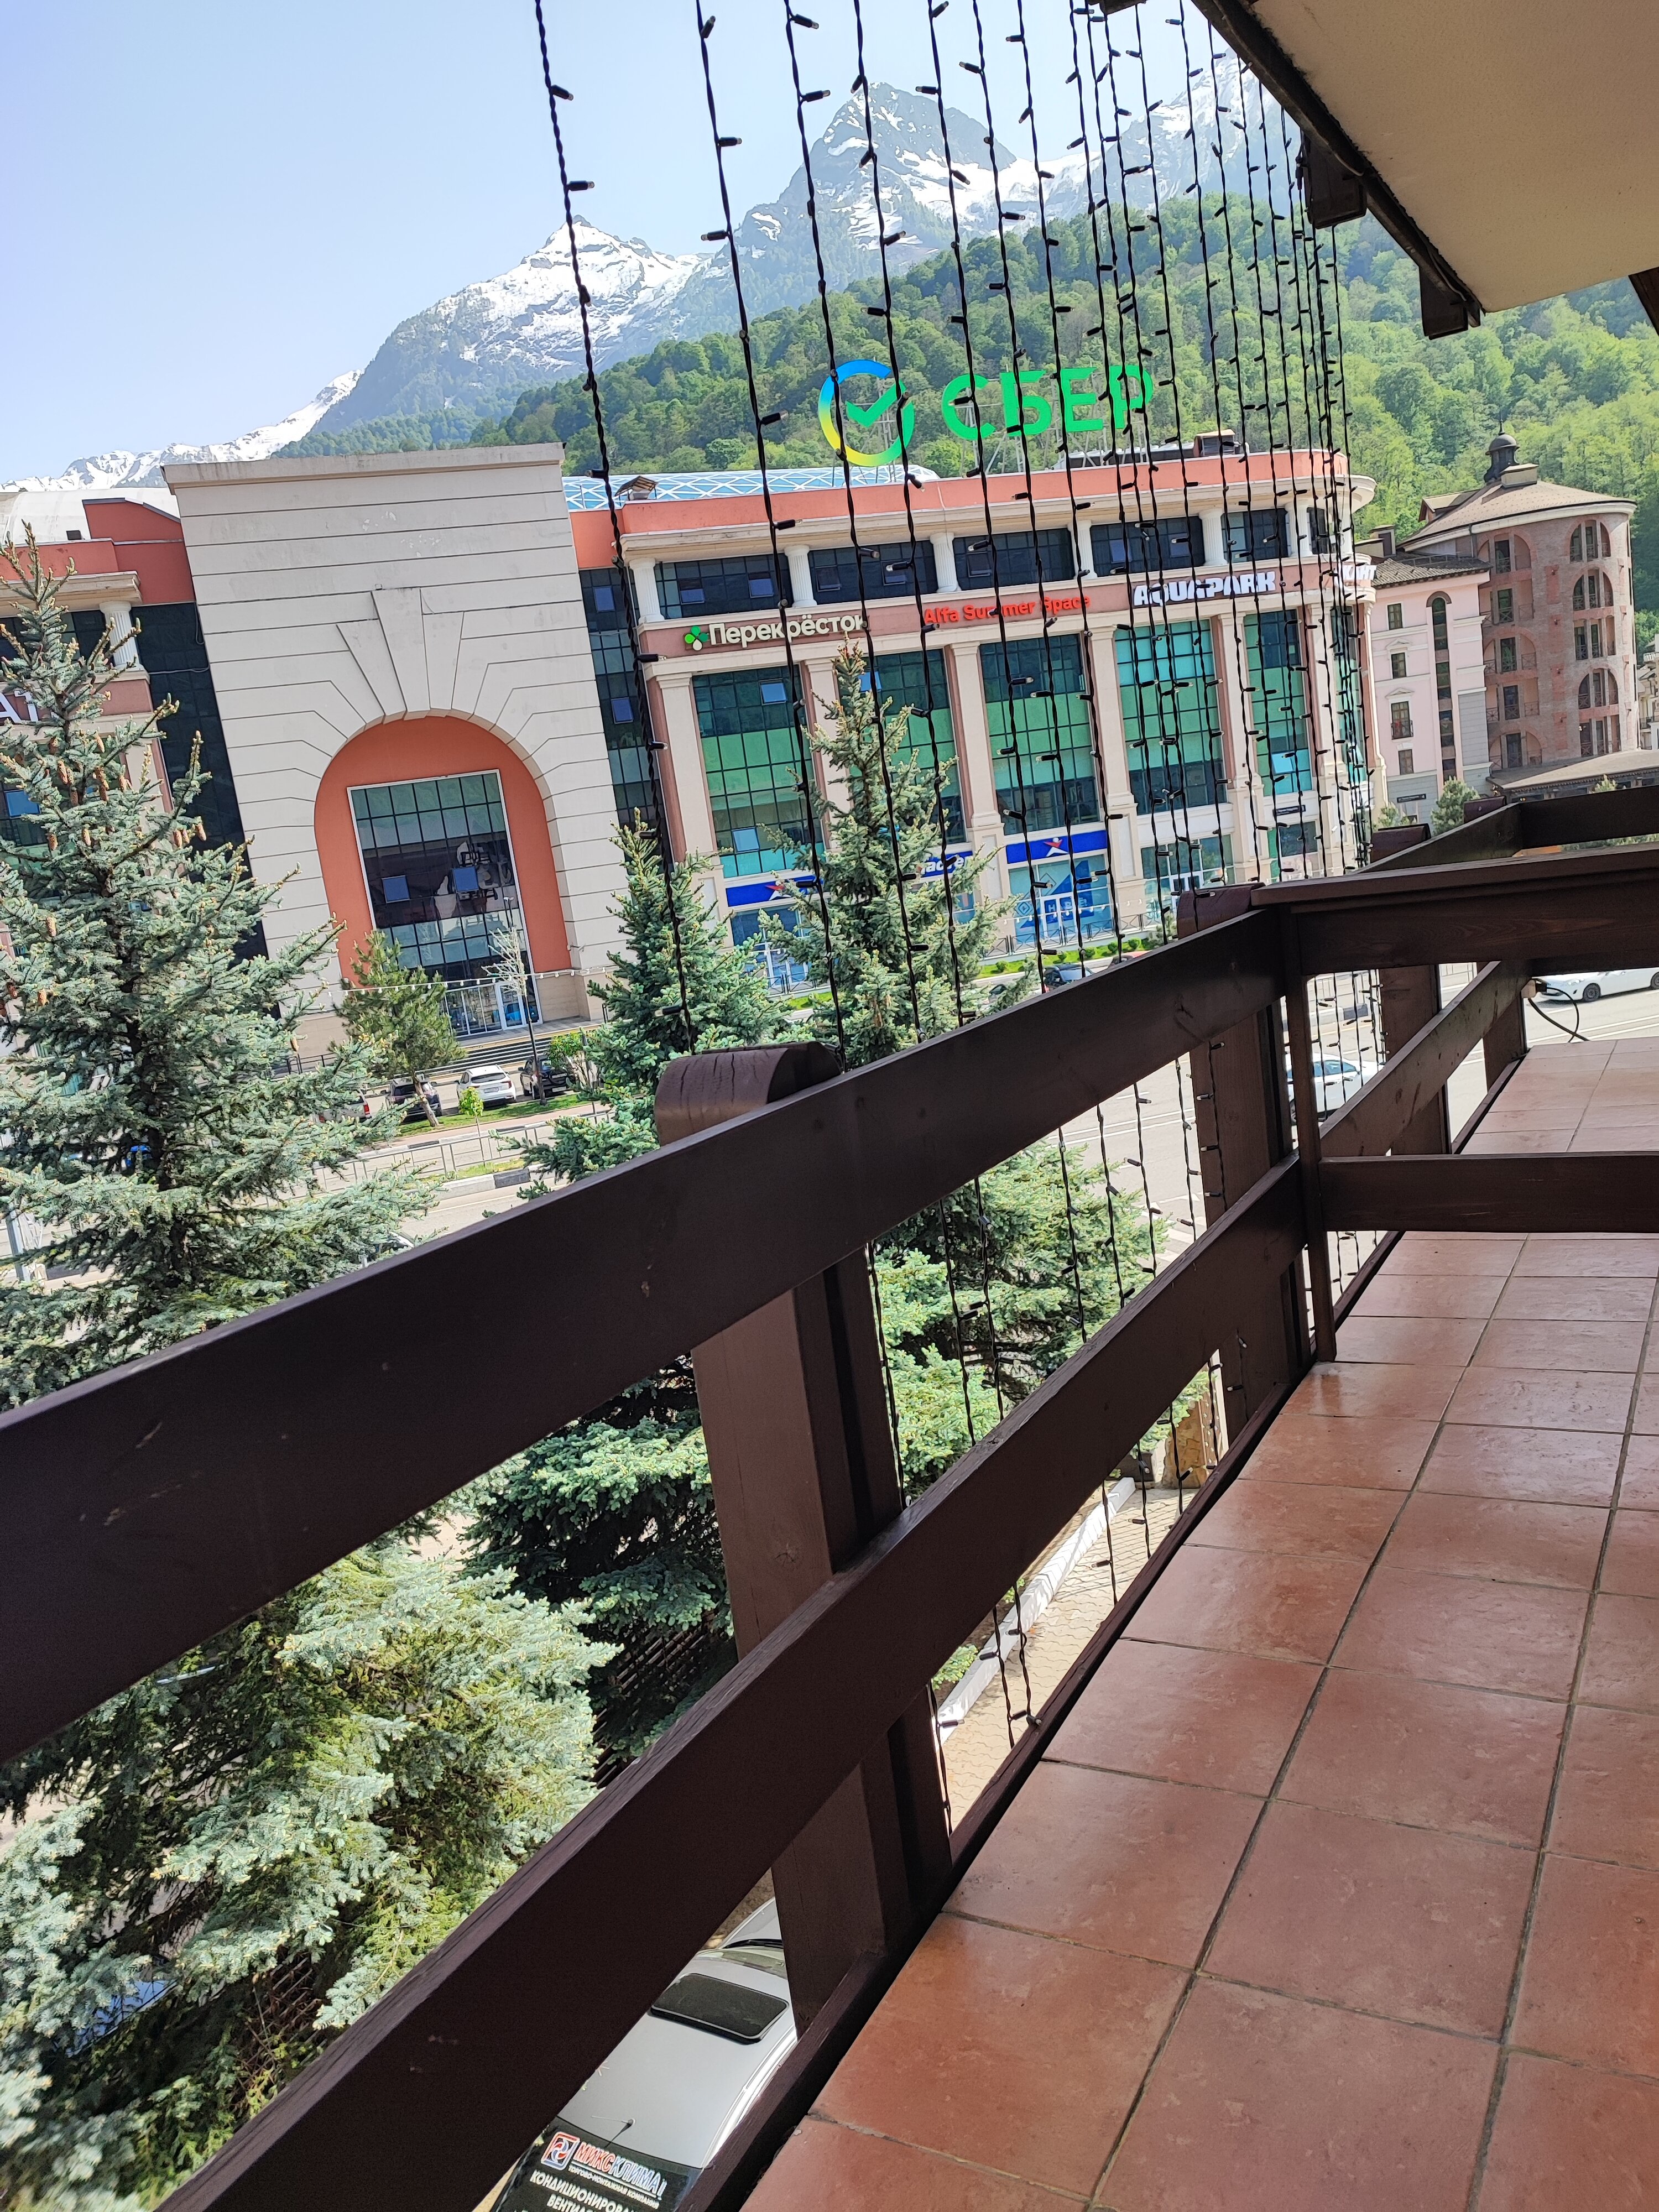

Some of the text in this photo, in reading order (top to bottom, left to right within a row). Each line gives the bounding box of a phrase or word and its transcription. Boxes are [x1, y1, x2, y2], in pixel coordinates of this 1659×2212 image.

[942, 364, 1154, 440] СБЕР
[1134, 571, 1276, 606] AQUAPARK
[924, 606, 960, 623] Alfa
[1041, 596, 1091, 614] Space
[708, 614, 865, 648] Перекрёсток
[529, 2169, 634, 2212] КОНДИЦИОНИРОВ
[546, 2194, 597, 2212] ВЕНТИЛ
[626, 2190, 660, 2210] КОМПАНИЯ
